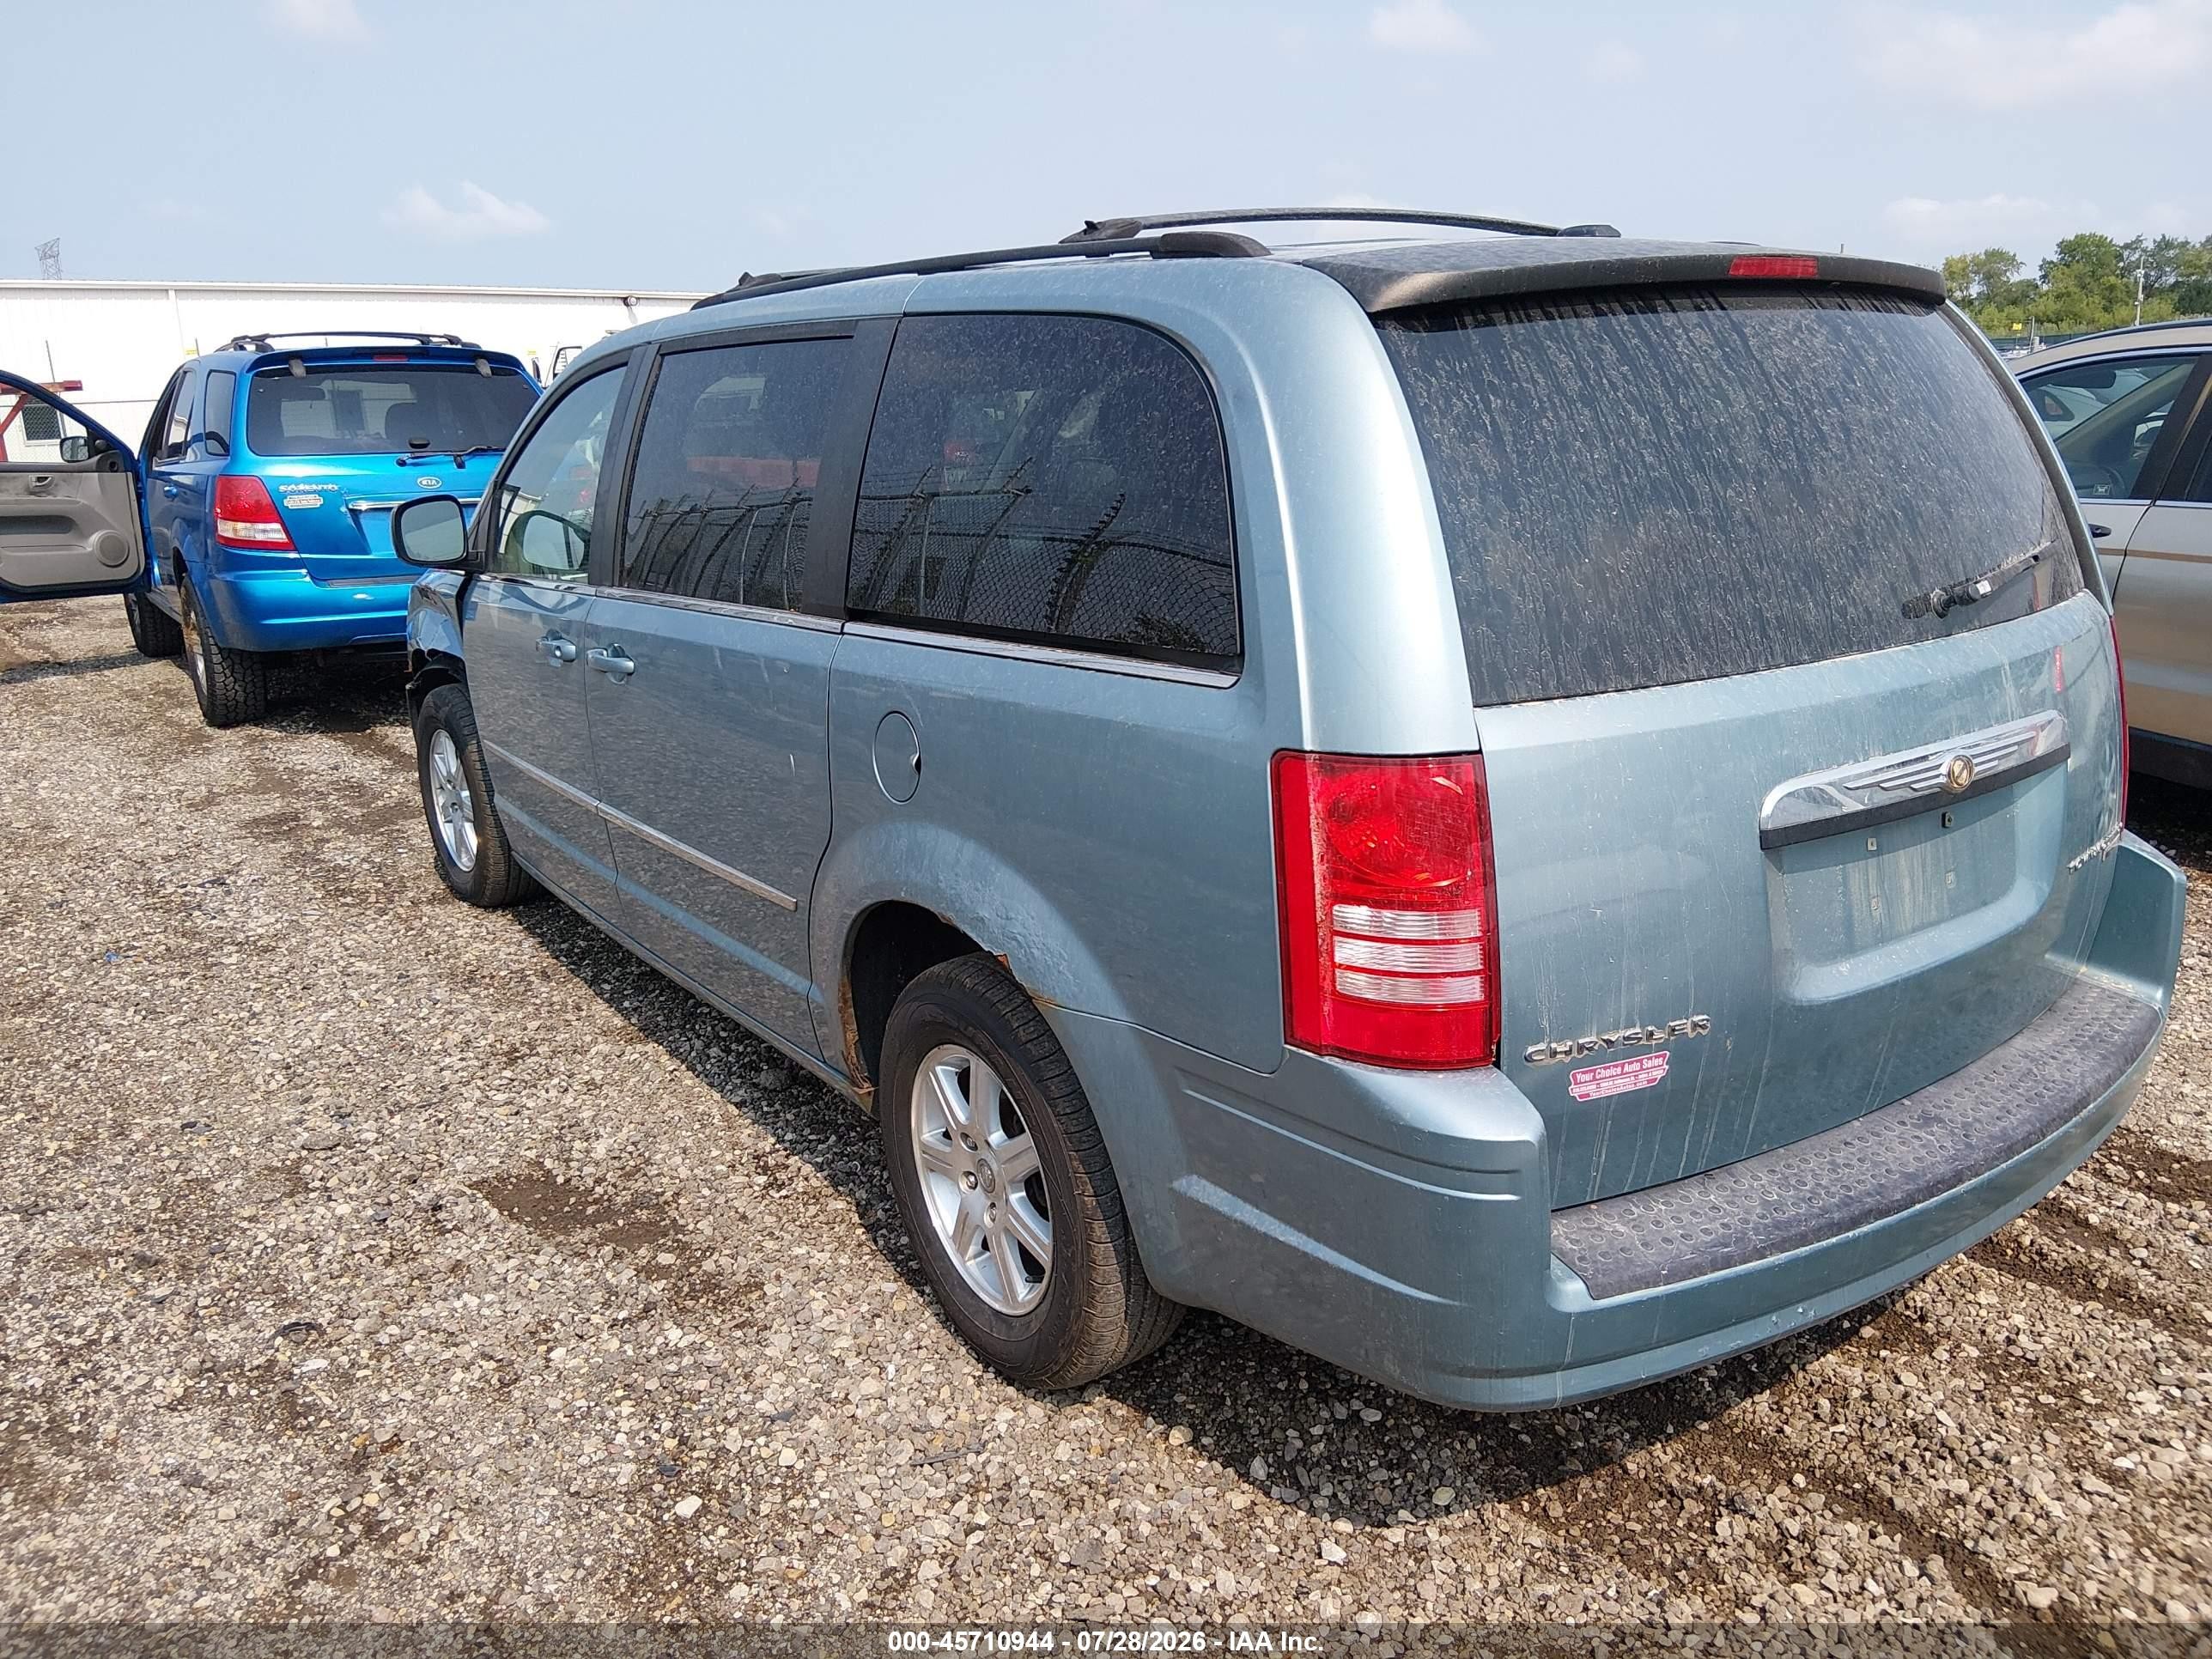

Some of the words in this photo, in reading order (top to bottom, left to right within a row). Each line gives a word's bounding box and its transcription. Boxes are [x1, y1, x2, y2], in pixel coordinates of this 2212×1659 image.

[1524, 1014, 1711, 1064] CHRYSLER
[1576, 1073, 1595, 1084] Your
[1595, 1067, 1622, 1080] Choice
[1623, 1062, 1641, 1074] Auto
[1642, 1056, 1664, 1069] Sales
